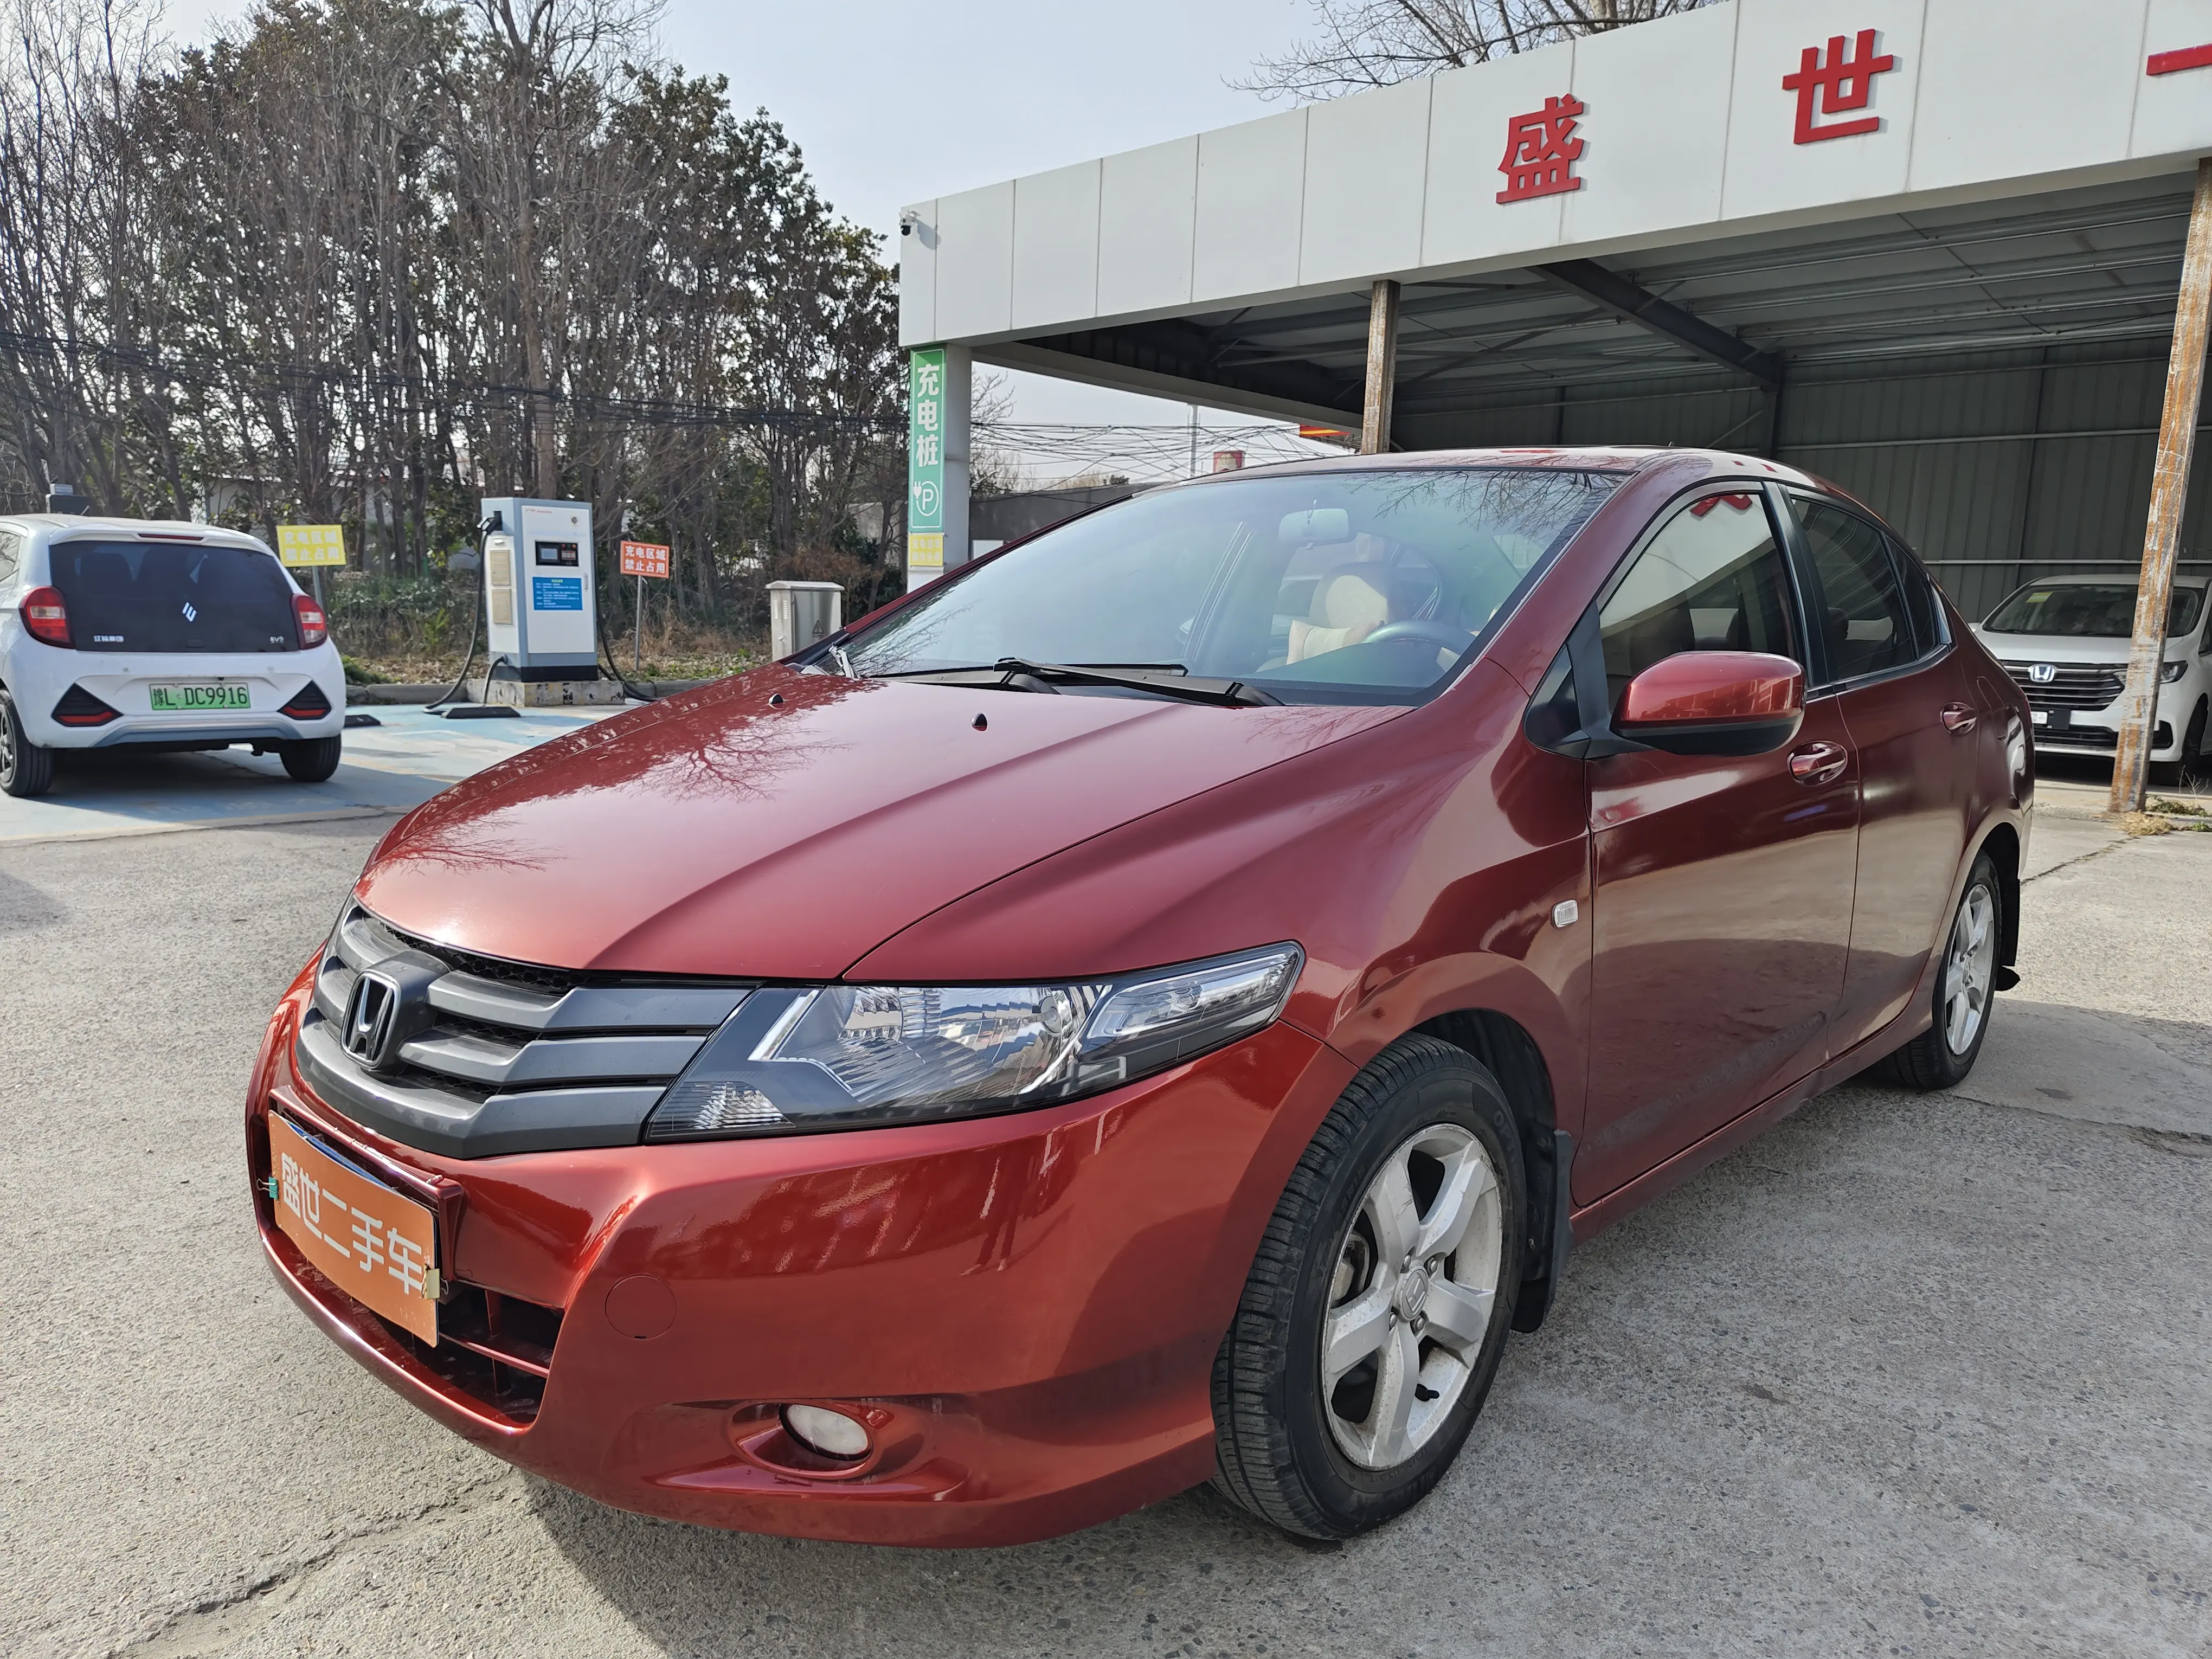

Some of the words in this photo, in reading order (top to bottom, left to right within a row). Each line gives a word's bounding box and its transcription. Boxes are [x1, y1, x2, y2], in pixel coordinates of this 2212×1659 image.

[916, 364, 940, 467] 充电桩
[625, 545, 666, 561] 充电区域
[625, 559, 666, 574] 禁止占用
[281, 1153, 422, 1295] 盛世二手车
